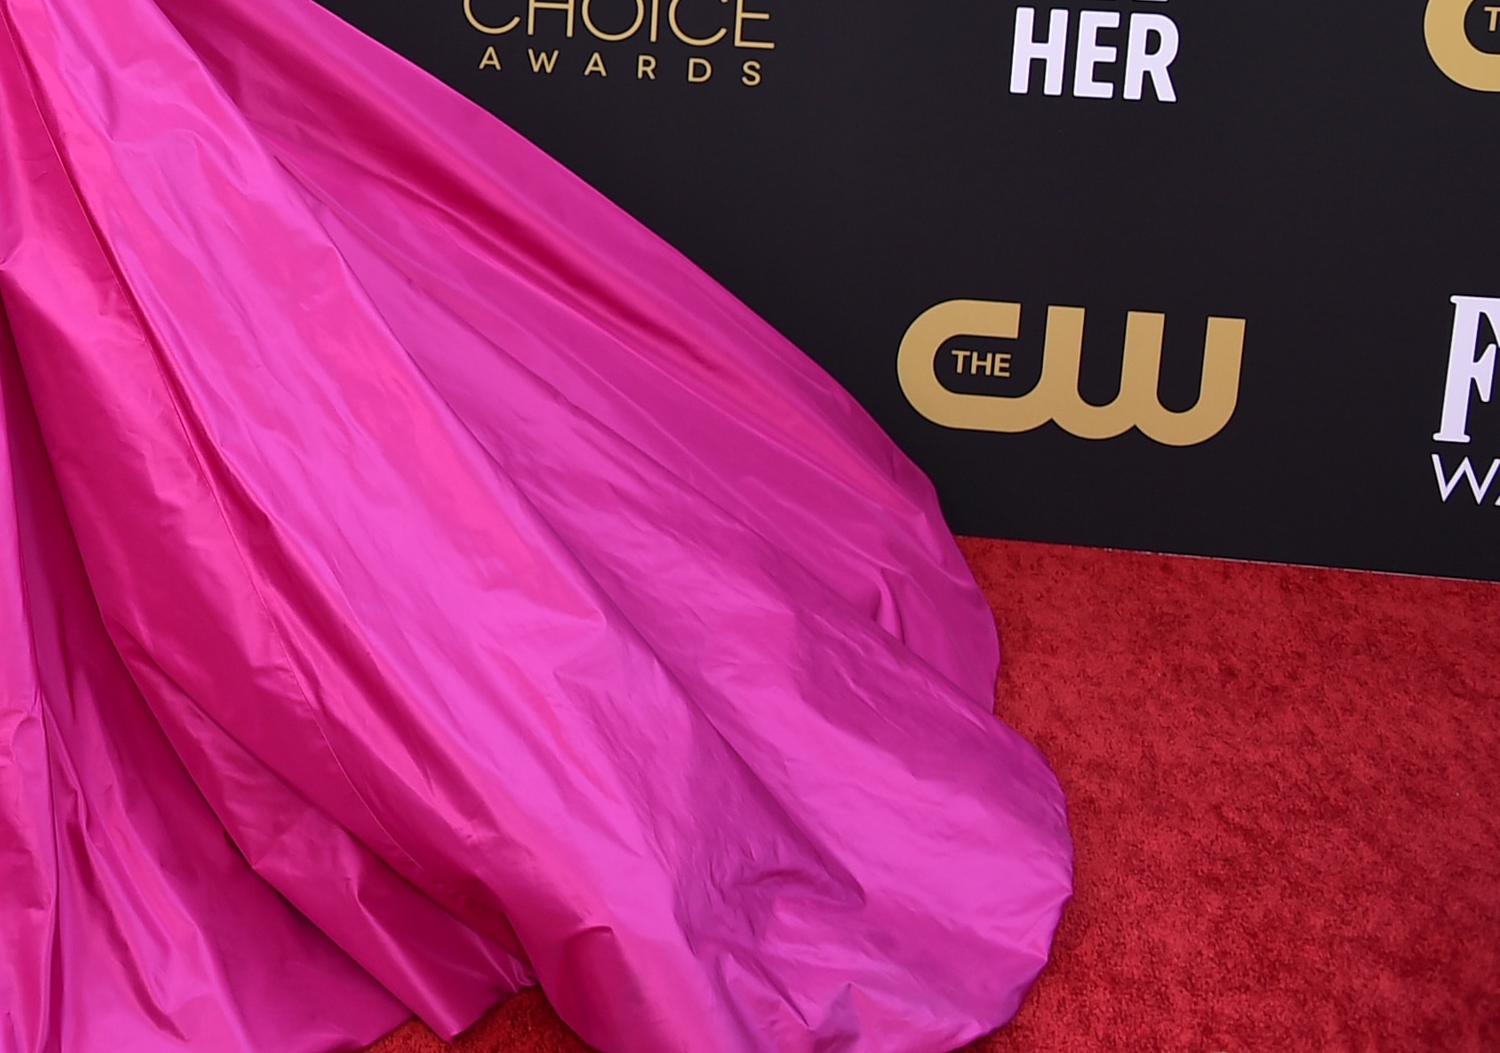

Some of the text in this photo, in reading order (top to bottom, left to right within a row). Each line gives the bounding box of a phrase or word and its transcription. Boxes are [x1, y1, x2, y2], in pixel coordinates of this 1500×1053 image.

[480, 47, 760, 85] AWARDS
[1010, 7, 1178, 101] HER
[897, 300, 1245, 446] CW
[952, 350, 1011, 377] THE
